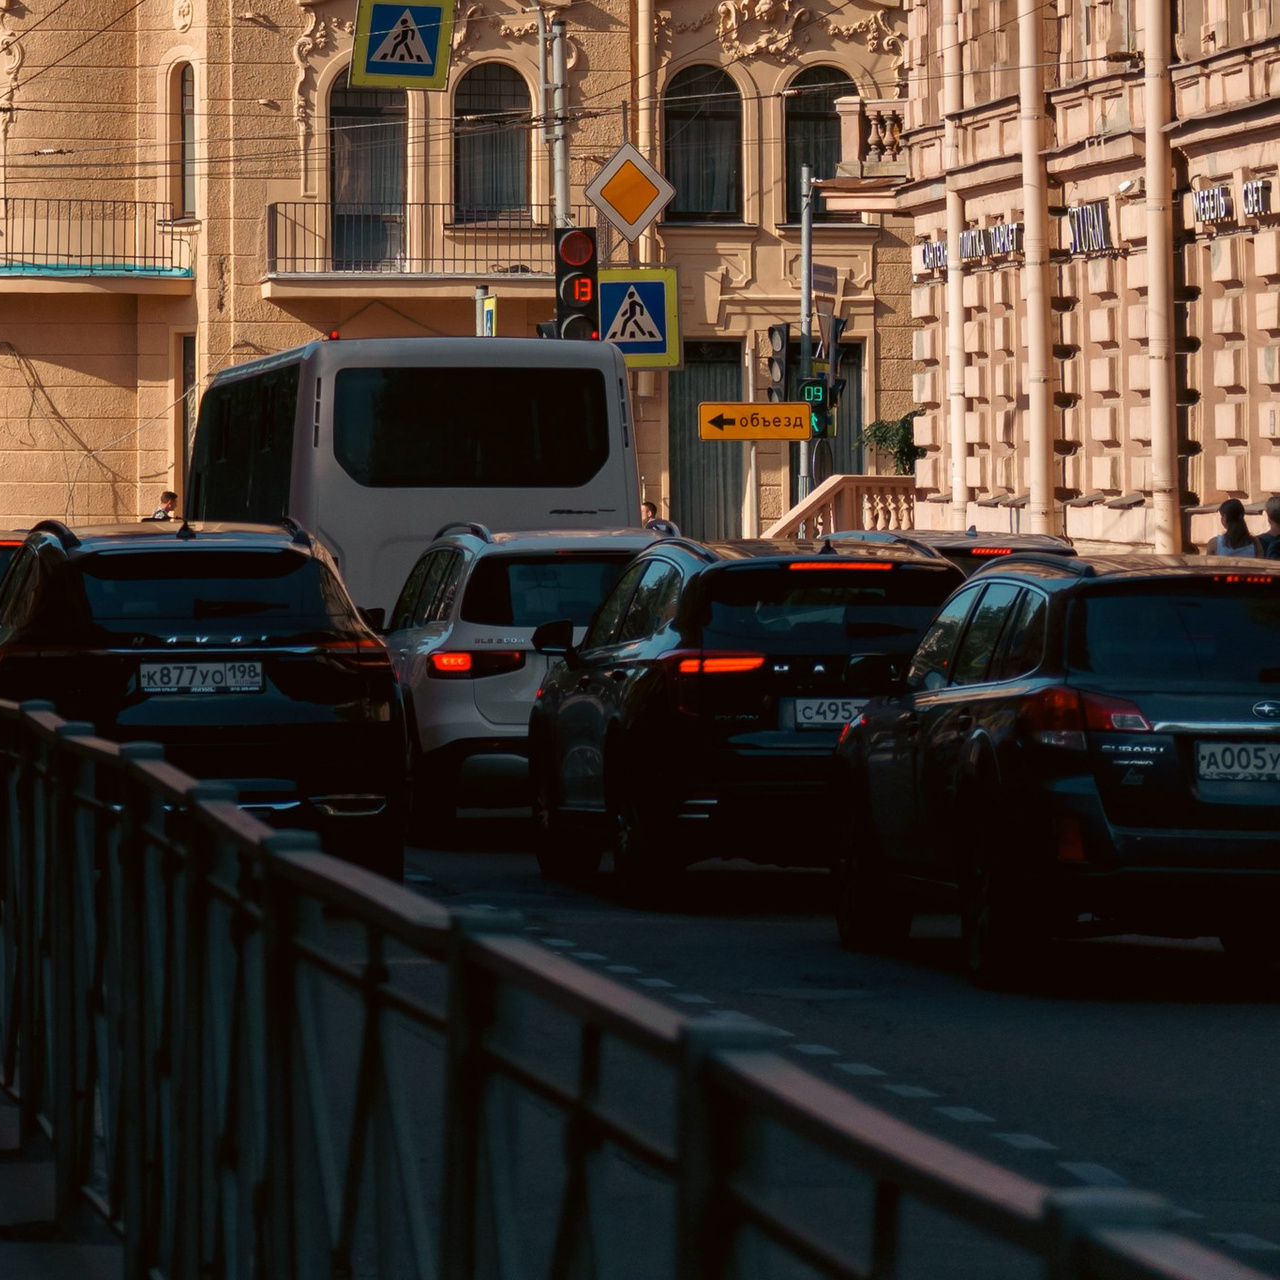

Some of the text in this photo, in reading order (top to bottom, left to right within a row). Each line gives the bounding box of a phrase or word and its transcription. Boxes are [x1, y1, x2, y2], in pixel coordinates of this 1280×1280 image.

[1193, 180, 1263, 222] МЕБЕЛЬ СВЕТ
[1067, 202, 1106, 254] STURM
[922, 241, 948, 269] САНТЕХН
[989, 223, 1017, 255] ПАРКЕТ
[574, 277, 593, 301] 13
[804, 386, 823, 402] 09
[739, 413, 804, 430] объезд
[147, 664, 257, 686] К877УО 198
